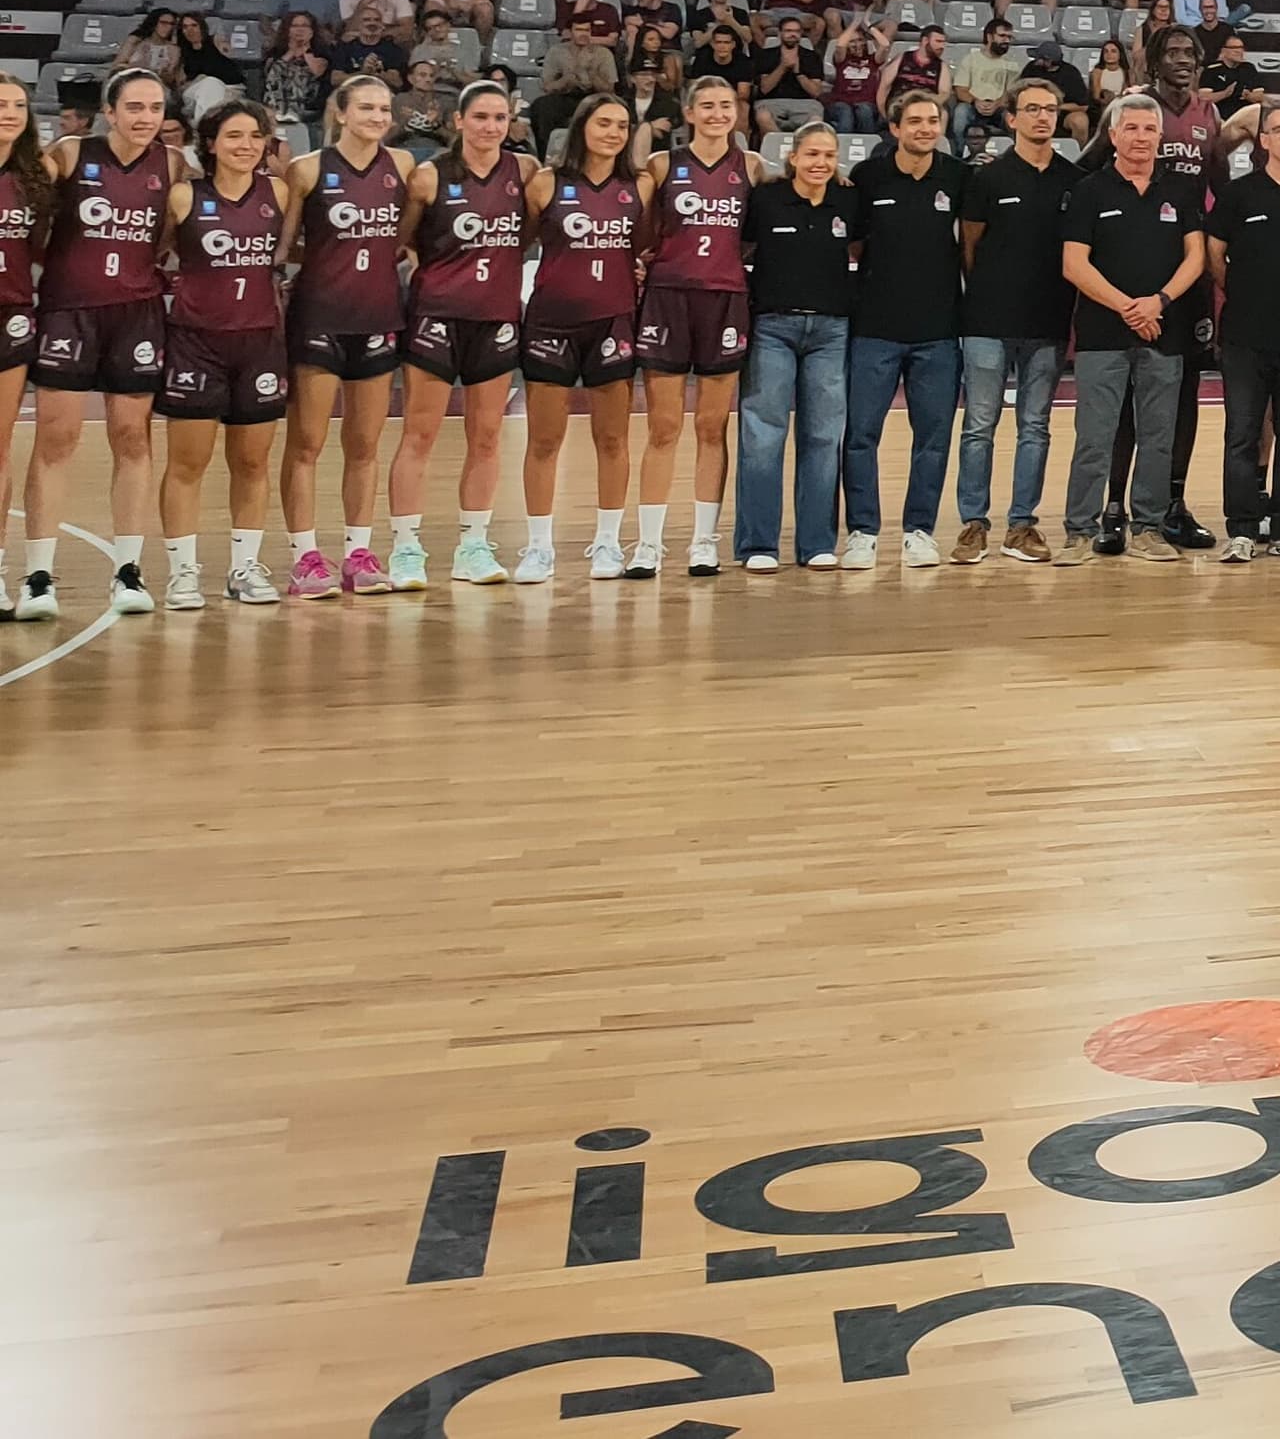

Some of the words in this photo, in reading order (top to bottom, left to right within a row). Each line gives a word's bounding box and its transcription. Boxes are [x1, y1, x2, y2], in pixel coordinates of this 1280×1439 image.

[79, 196, 158, 227] Gust
[328, 201, 400, 229] Gust
[674, 190, 742, 215] Gust
[0, 206, 37, 226] ust
[453, 211, 522, 240] Gust
[563, 211, 634, 240] Gust
[201, 229, 277, 256] Gust
[697, 234, 712, 257] 2
[105, 252, 120, 277] 9
[356, 248, 370, 271] 6
[476, 258, 491, 282] 5
[591, 259, 604, 282] 4
